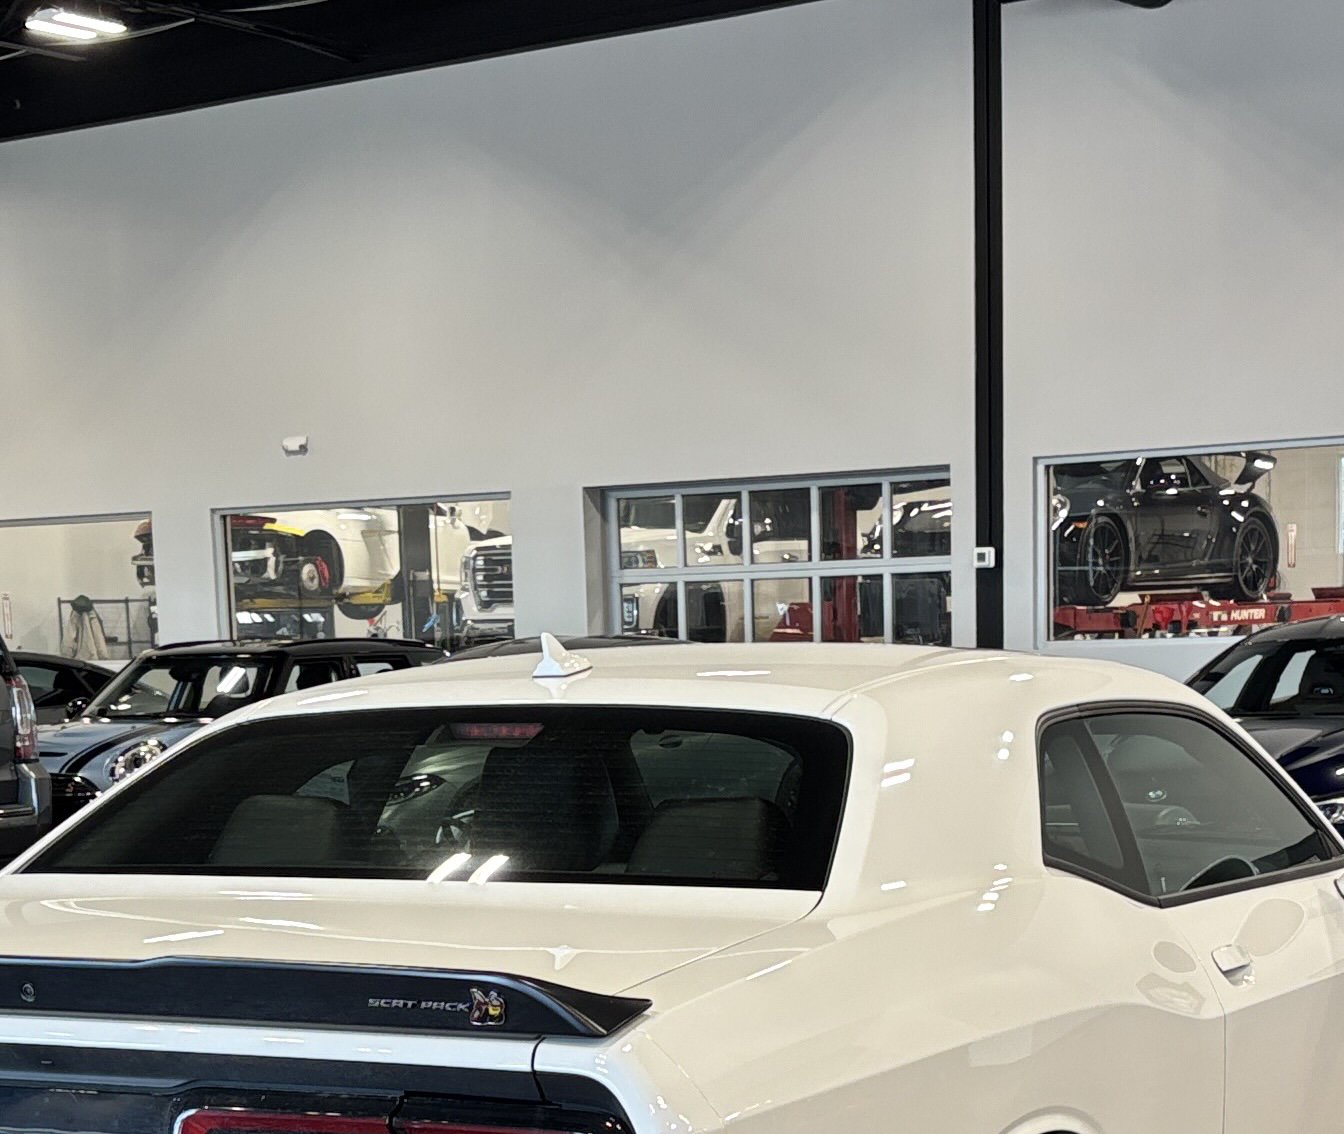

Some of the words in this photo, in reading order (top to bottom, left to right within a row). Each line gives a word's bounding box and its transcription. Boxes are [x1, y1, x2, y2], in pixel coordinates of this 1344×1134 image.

[1230, 608, 1266, 621] HUNTER
[367, 998, 418, 1009] SCAT
[419, 1001, 471, 1012] PACK
